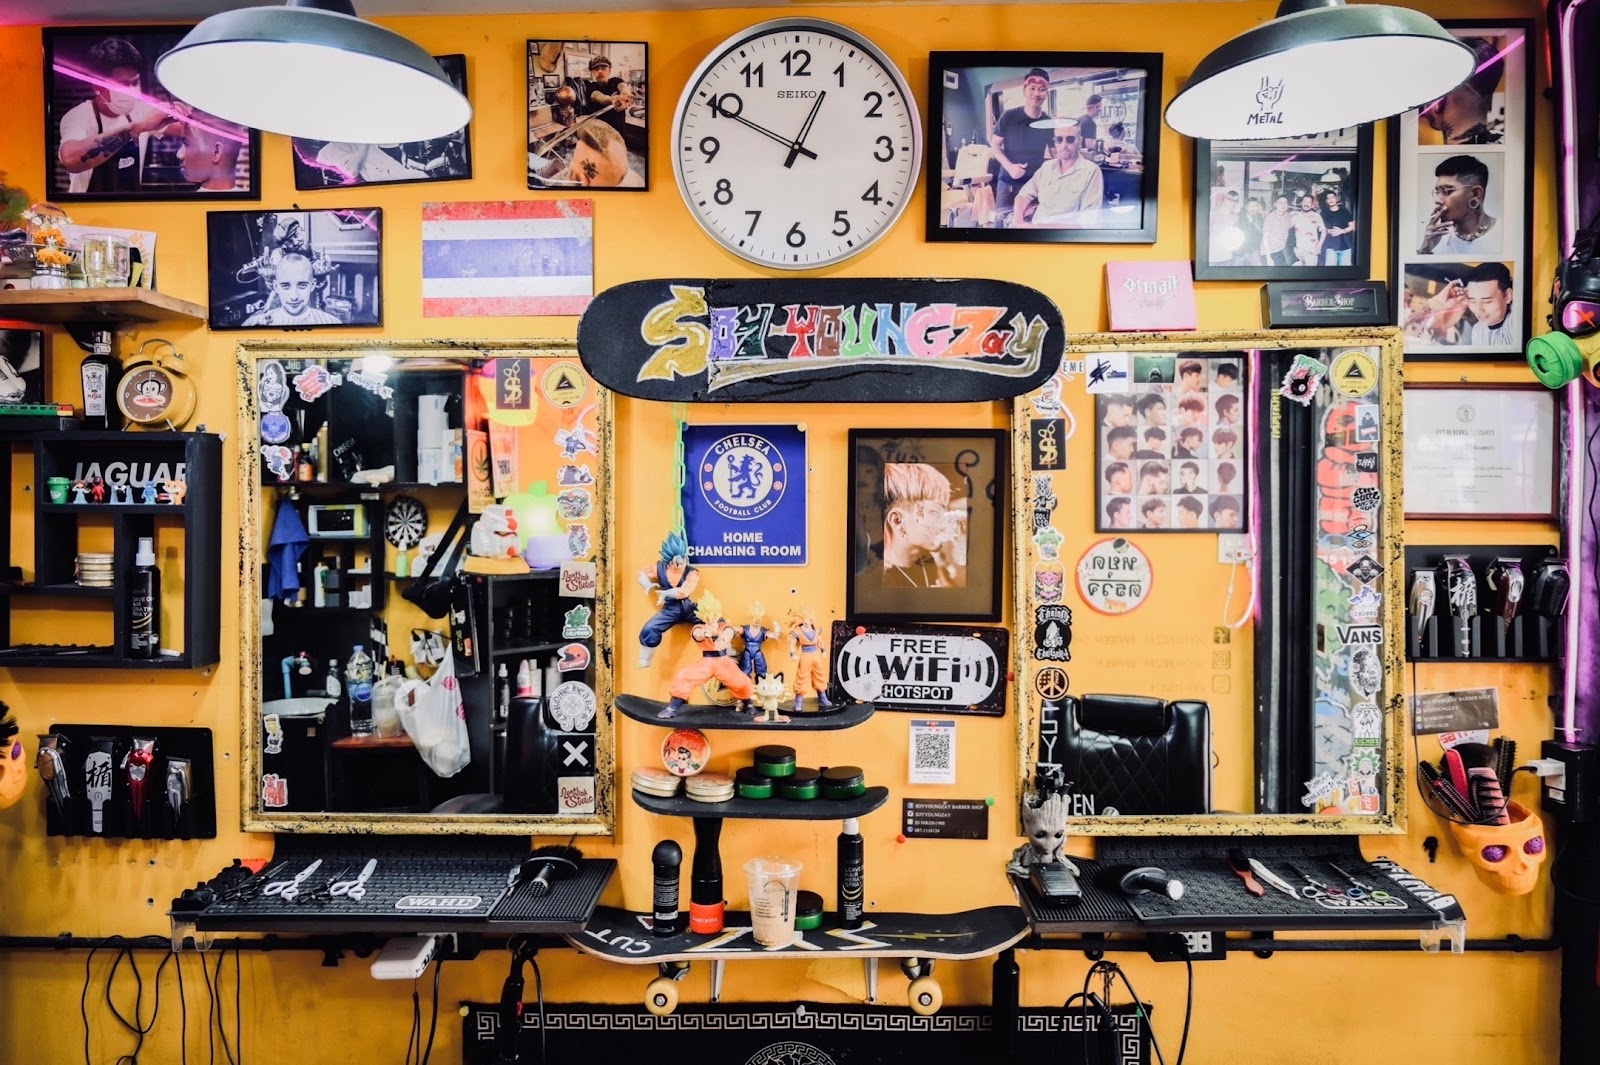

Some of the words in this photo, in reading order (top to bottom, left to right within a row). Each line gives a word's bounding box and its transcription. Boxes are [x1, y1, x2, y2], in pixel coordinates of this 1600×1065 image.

[739, 61, 764, 88] 11
[780, 49, 812, 77] 12
[832, 61, 845, 88] 1
[707, 92, 744, 119] 10
[777, 90, 817, 99] SEIKO
[863, 91, 883, 118] 2
[1246, 111, 1284, 126] METAL
[699, 136, 721, 164] 9
[873, 135, 895, 163] 3
[713, 178, 734, 206] 8
[860, 179, 883, 206] 4
[744, 210, 763, 237] 7
[785, 221, 807, 248] 6
[831, 210, 851, 237] 5
[714, 436, 771, 456] CHELSEA
[714, 499, 751, 516] FOOTBALL
[753, 499, 772, 513] CLUB
[723, 532, 763, 543] HOME
[686, 546, 756, 557] CHANGING
[760, 546, 801, 556] ROOM
[890, 638, 947, 655] FREE
[1336, 625, 1382, 644] VANS
[876, 654, 961, 683] WiFi
[884, 685, 950, 700] HOTSPOT
[409, 898, 473, 907] WAHL
[584, 929, 651, 954] CUT
